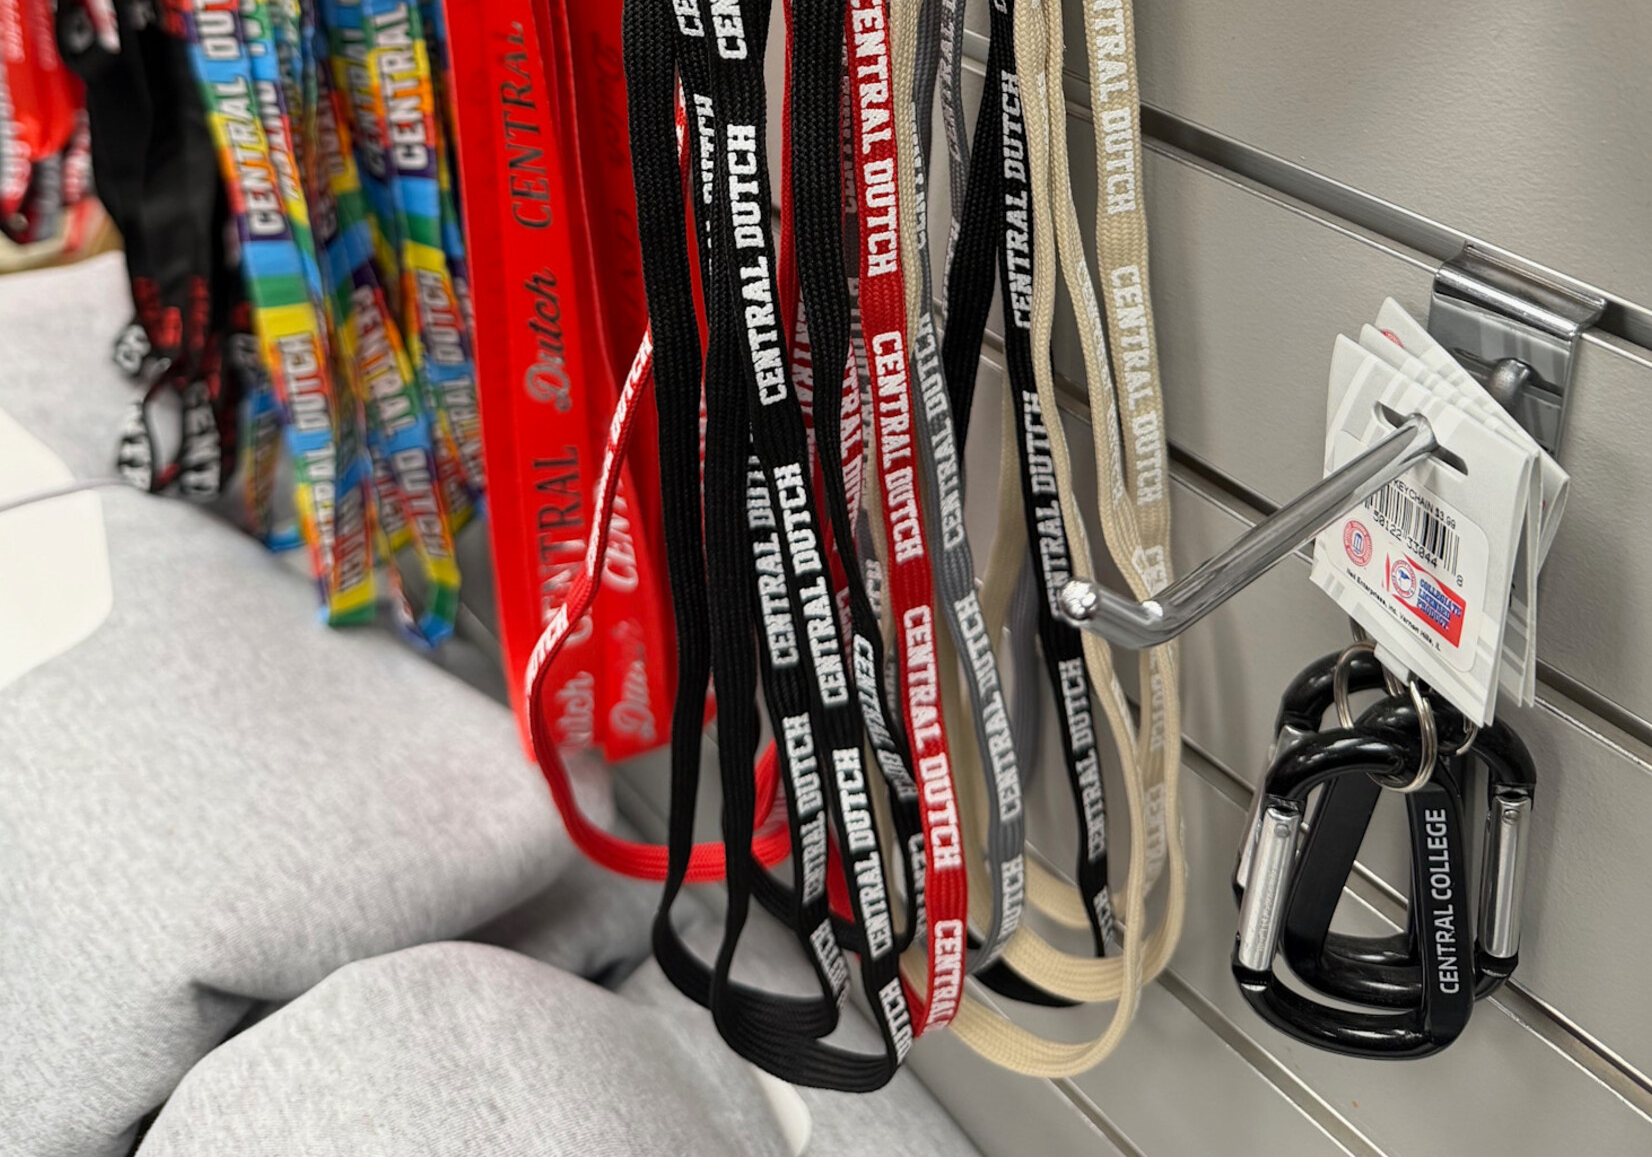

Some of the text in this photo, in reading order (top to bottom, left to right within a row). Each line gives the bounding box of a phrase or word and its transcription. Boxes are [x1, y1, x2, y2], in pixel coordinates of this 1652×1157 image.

[215, 75, 286, 236] CENTRAL
[374, 1, 429, 171] CENTRAL
[501, 20, 554, 230] CENTRAL
[1100, 103, 1137, 216] DUTCH
[727, 124, 787, 405] CENTRAL DUTCH
[863, 157, 898, 278] DUTCH
[1001, 70, 1033, 331] CENTRAL DUTCH
[278, 333, 332, 433] DUTCH
[418, 269, 466, 366] DUTCH
[523, 266, 572, 413] Dutch
[1111, 265, 1154, 411] CENTRAL
[353, 285, 417, 438] CENTRAL
[393, 448, 450, 557] DUTCH
[872, 330, 924, 565] CENTRAL DUTCH
[914, 312, 966, 551] CENTRAL DUTCH
[1022, 390, 1058, 496] DUTCH
[1132, 410, 1163, 507] DUTCH
[753, 532, 799, 670] CENTRAL
[773, 462, 850, 708] CENTRAL DUTCH
[1418, 588, 1451, 621] LICENSED
[1420, 578, 1462, 618] COLLEGIATE
[1456, 574, 1464, 588] 8
[782, 711, 824, 820] DUTCH
[853, 633, 897, 751] CENTRAL
[903, 604, 964, 873] CENTRAL DUTCH
[953, 589, 1022, 823] CENTRAL DUTCH
[1059, 657, 1108, 863] CENTRAL DUTCH
[832, 747, 894, 962] CENTRAL DUTCH
[1424, 808, 1460, 995] CENTRAL COLLEGE
